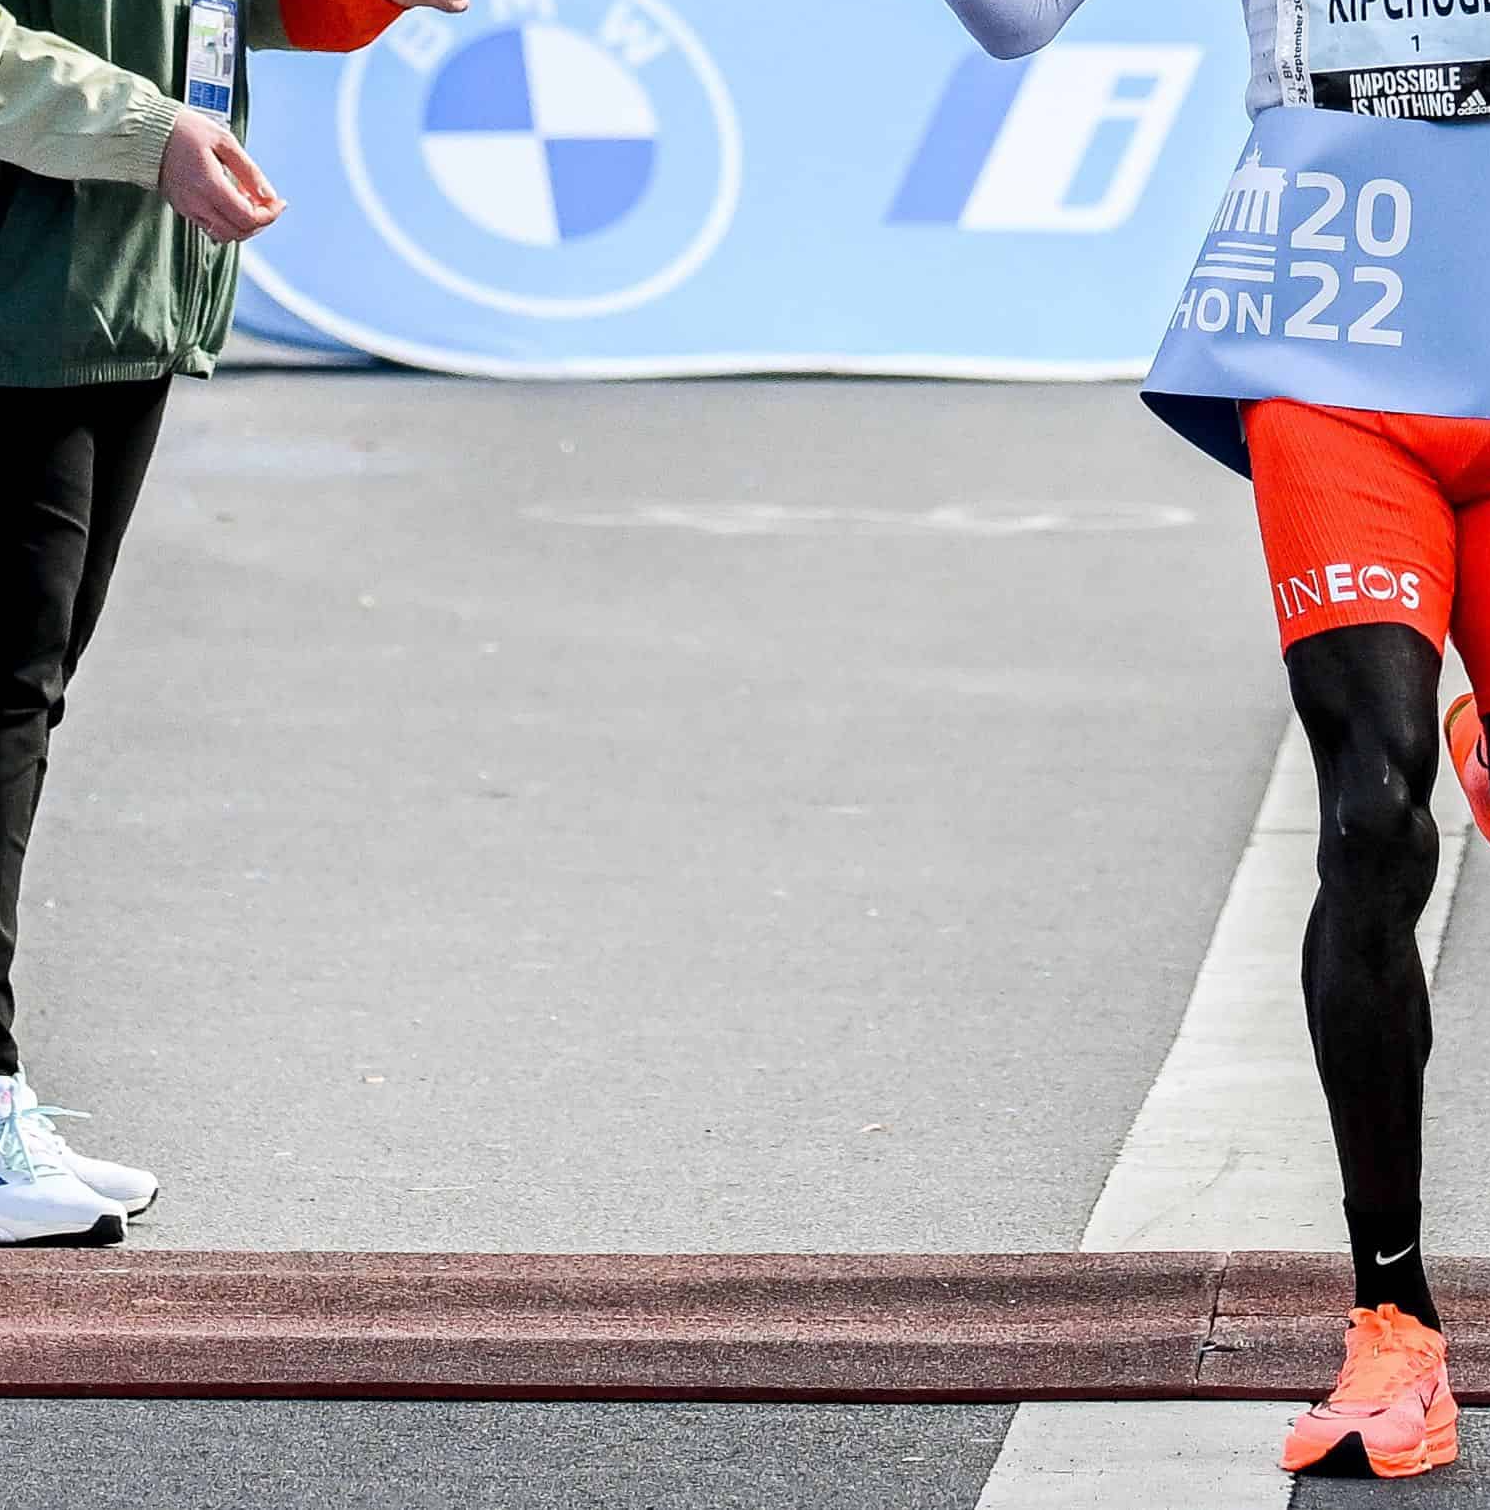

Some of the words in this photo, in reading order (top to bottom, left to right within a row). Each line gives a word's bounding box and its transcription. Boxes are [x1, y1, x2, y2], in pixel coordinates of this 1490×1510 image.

[1293, 14, 1306, 82] September
[1410, 34, 1420, 52] 1
[1349, 66, 1462, 98] IMPOSSIBLE
[1351, 98, 1370, 116] IS
[1371, 91, 1456, 119] NOTHING
[1290, 171, 1412, 258] 20
[1283, 260, 1404, 347] 22
[1276, 563, 1421, 620] INEOS
